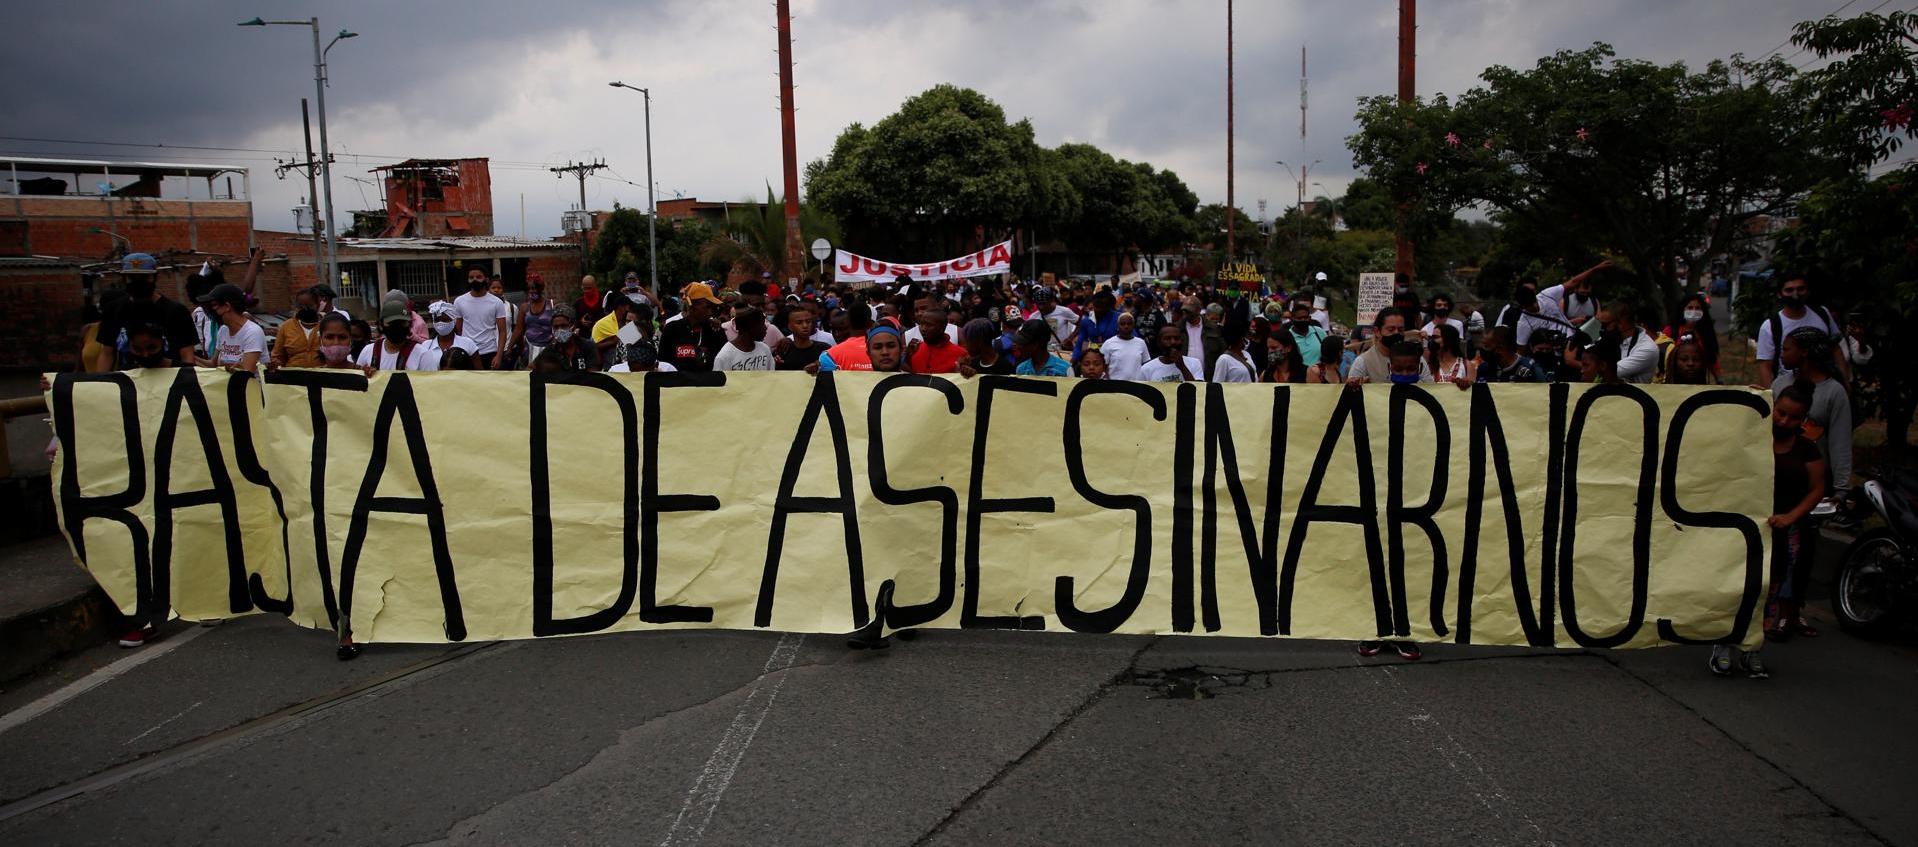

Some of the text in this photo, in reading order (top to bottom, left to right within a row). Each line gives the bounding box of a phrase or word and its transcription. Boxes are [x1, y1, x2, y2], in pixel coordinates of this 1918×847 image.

[839, 243, 1011, 277] JUSTICIA
[1222, 262, 1257, 274] LA VIDA
[52, 369, 1772, 648] BASTA DE ASESINARNOS
